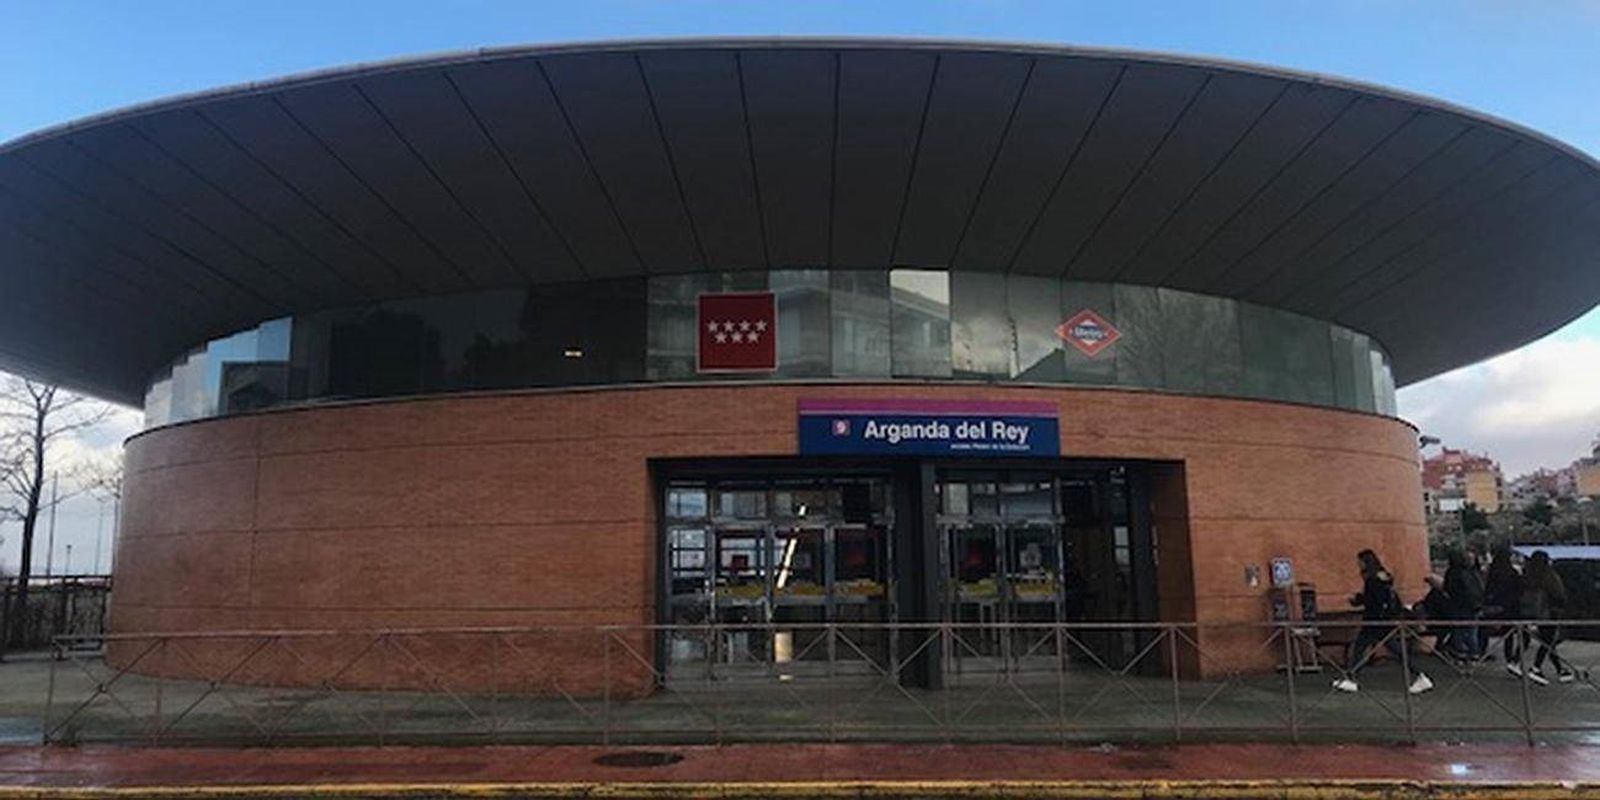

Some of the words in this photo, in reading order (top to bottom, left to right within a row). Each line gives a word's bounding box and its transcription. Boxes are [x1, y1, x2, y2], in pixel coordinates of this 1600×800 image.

[864, 420, 950, 443] Arganda
[955, 421, 986, 439] del
[992, 422, 1029, 445] Rey
